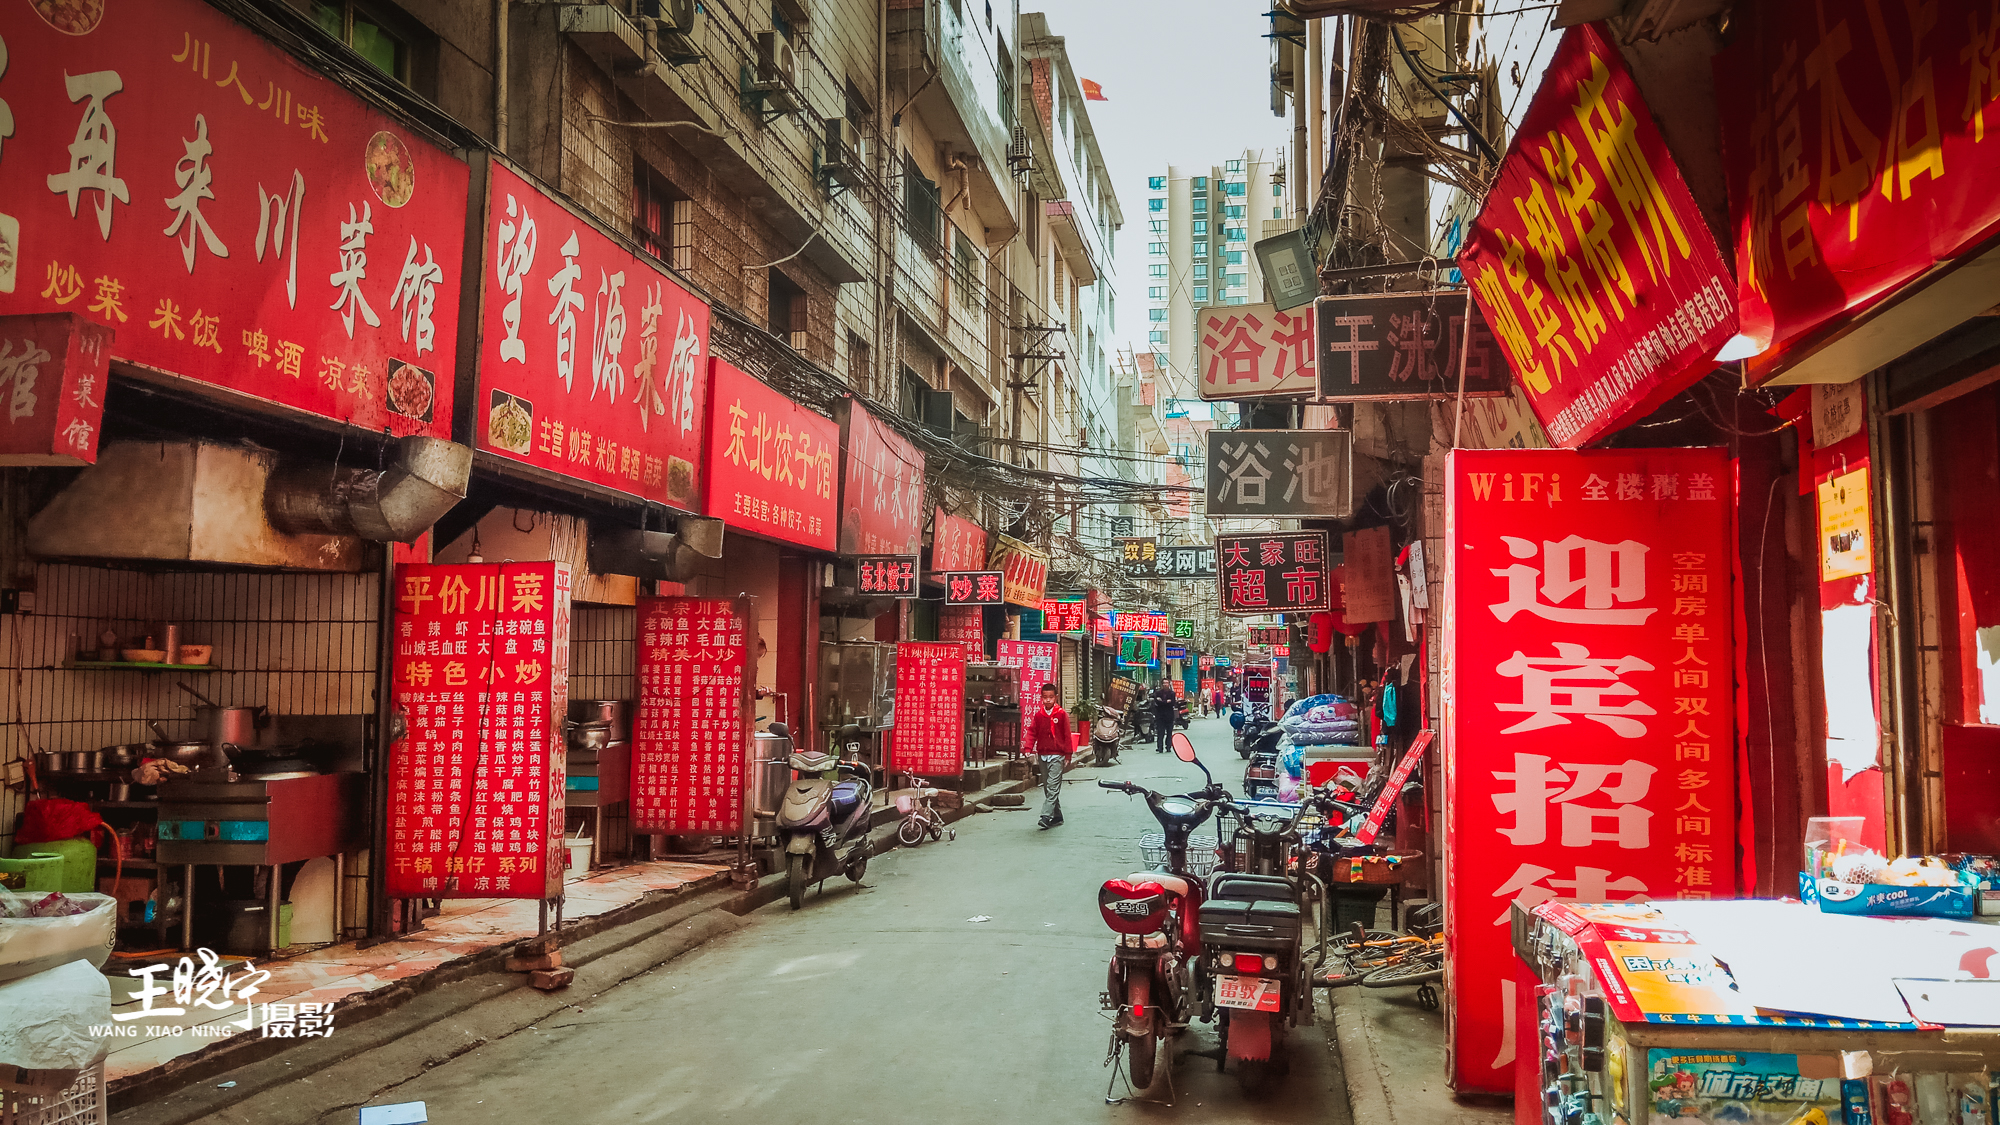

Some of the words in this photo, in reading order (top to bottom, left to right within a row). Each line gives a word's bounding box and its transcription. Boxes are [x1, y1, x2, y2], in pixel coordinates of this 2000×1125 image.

[172, 31, 328, 143] 川人川味
[0, 32, 444, 357] 再来川菜馆
[497, 193, 700, 440] 望香源菜馆
[41, 260, 127, 322] 炒菜
[149, 298, 223, 354] 米饭
[241, 328, 304, 379] 啤酒
[318, 355, 374, 401] 凉菜
[1203, 311, 1315, 385] 浴池
[1330, 309, 1491, 385] 干洗店
[62, 333, 104, 452] 川菜馆
[538, 416, 563, 457] 主营
[568, 425, 591, 467] 炒菜
[595, 435, 616, 474] 米饭
[620, 446, 640, 483] 啤酒
[643, 453, 662, 490] 凉菜
[723, 398, 832, 501] 东北饺子馆
[853, 424, 920, 532] 川味菜馆
[1217, 440, 1338, 505] 浴池
[1468, 473, 1562, 503] WiFi
[1581, 472, 1717, 502] 全楼覆盖
[1125, 541, 1156, 562] 纹身
[1224, 538, 1321, 567] 大家旺
[860, 560, 914, 593] 东北饺子
[401, 572, 545, 616] 平价川菜
[949, 574, 1000, 602] 炒菜
[1229, 566, 1320, 608] 超市
[651, 601, 734, 615] 正宗川菜
[1044, 602, 1083, 616] 锅巴饭
[401, 620, 469, 637] 香辣虾
[477, 618, 546, 636] 上品老碗鱼
[644, 617, 690, 631] 老碗鱼
[696, 617, 743, 631] 大盘鸡
[1047, 615, 1080, 631] 冒菜
[1175, 620, 1193, 638] 药
[400, 640, 468, 656] 山城毛血旺
[477, 638, 546, 655] 大盘鸡
[643, 633, 690, 646] 香辣虾
[696, 632, 743, 647] 毛血旺
[650, 648, 736, 662] 精美小炒
[1028, 644, 1053, 657] 拉条子
[1121, 638, 1153, 663] 纹身
[405, 658, 543, 687] 特色小炒
[399, 691, 465, 703] 酸辣土豆丝
[478, 691, 543, 702] 酸辣白菜
[478, 704, 543, 715] 香菇肉片
[478, 716, 543, 727] 肉沫茄子
[477, 728, 543, 740] 青椒肉丝
[478, 740, 542, 752] 鱼香烘蛋
[396, 753, 463, 765] 泡菜肉丝
[477, 753, 541, 765] 苦瓜炒肉
[396, 766, 463, 778] 干煸豆角
[476, 766, 541, 778] 香干芹菜
[396, 778, 463, 790] 麻婆豆腐
[475, 778, 541, 790] 烧腐竹
[396, 791, 462, 803] 肉沫粉条
[475, 791, 540, 803] 红烧肥肠
[395, 804, 461, 815] 红烧带鱼
[475, 804, 540, 815] 红烧肉
[474, 816, 540, 828] 宫保鸡丁
[474, 829, 540, 841] 红烧鱼块
[394, 856, 433, 874] 干锅
[445, 856, 486, 874] 锅仔
[498, 855, 538, 874] 系列
[474, 875, 511, 891] 凉菜
[1886, 889, 1909, 901] COOL
[1701, 1071, 1824, 1101] 城市交通
